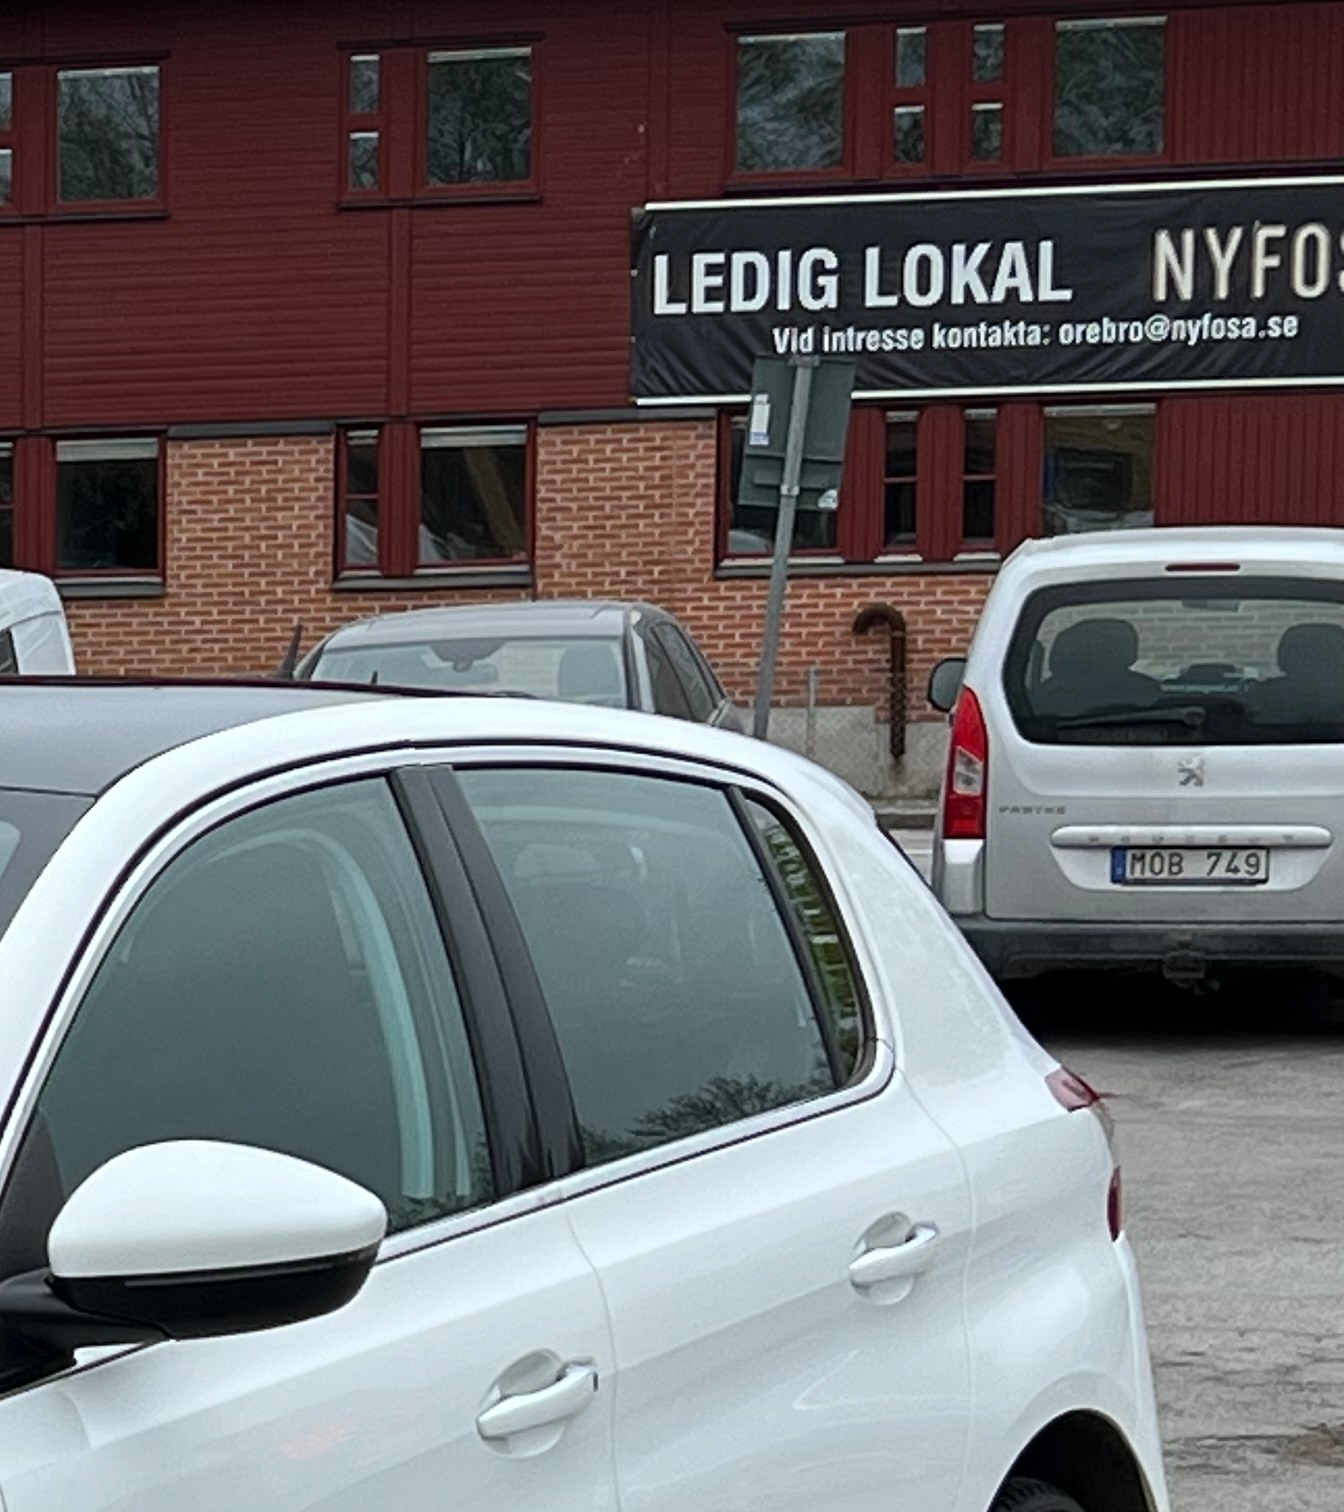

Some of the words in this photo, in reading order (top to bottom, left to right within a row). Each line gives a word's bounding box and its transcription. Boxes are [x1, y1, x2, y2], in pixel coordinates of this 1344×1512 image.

[653, 248, 840, 315] LEDIG
[864, 240, 1074, 308] LOKAL
[1153, 222, 1344, 302] NYFO
[772, 327, 814, 355] Vid
[823, 325, 924, 353] intresse
[932, 319, 1051, 349] kontakta:
[1058, 313, 1299, 347] orebro@nyfosa.se
[1129, 853, 1184, 877] MOB
[1206, 852, 1261, 876] 749
